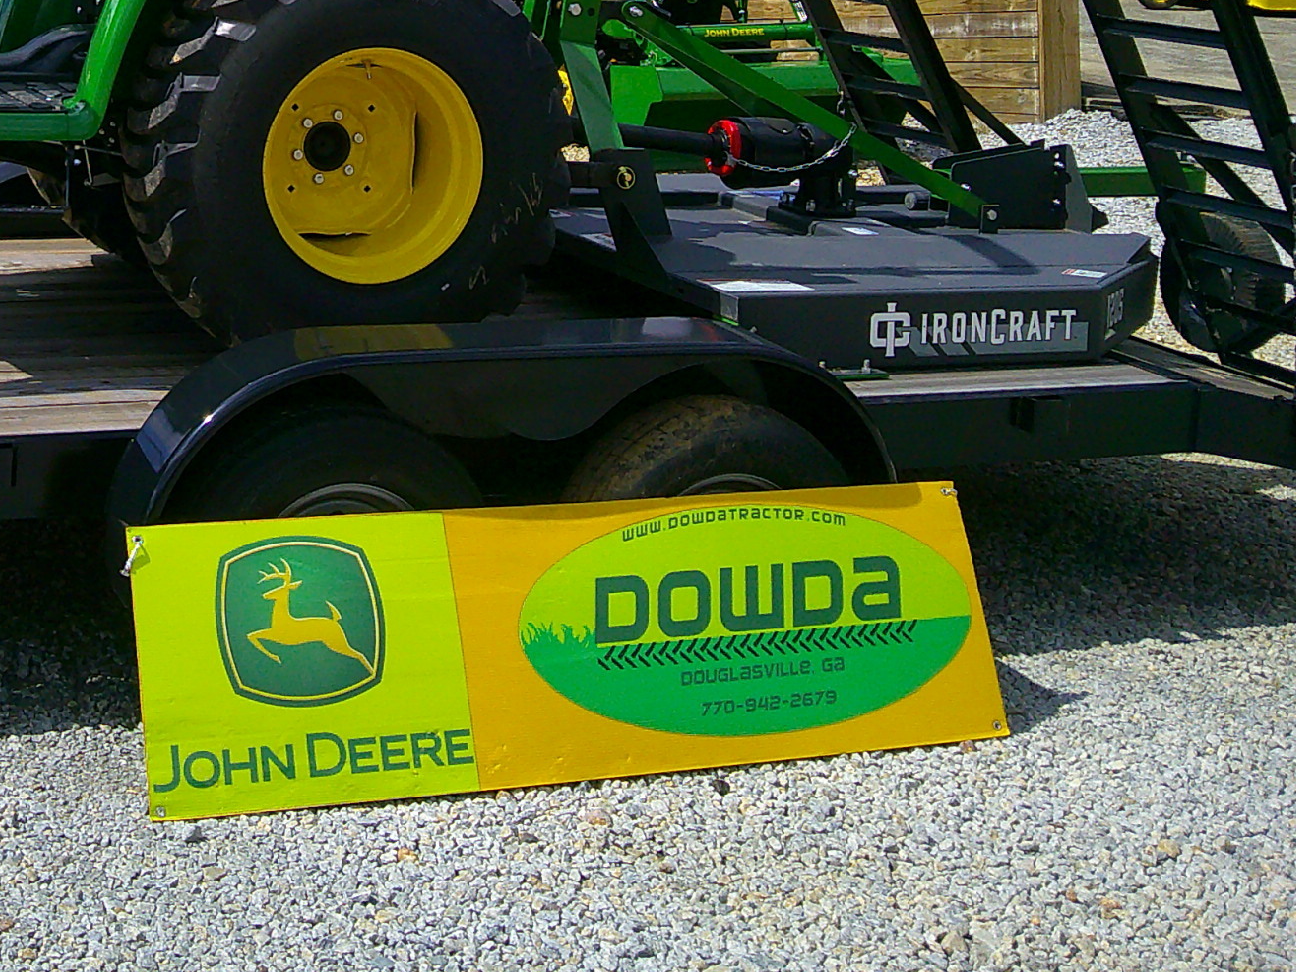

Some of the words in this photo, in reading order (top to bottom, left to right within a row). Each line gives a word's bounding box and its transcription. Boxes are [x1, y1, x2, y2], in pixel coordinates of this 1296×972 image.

[704, 28, 730, 38] JOHN
[731, 27, 765, 37] DEERE
[920, 308, 1078, 345] IRONCRAFT
[701, 689, 838, 717] 770-942-2679
[154, 743, 296, 794] JOHN
[305, 728, 475, 779] DEERE
